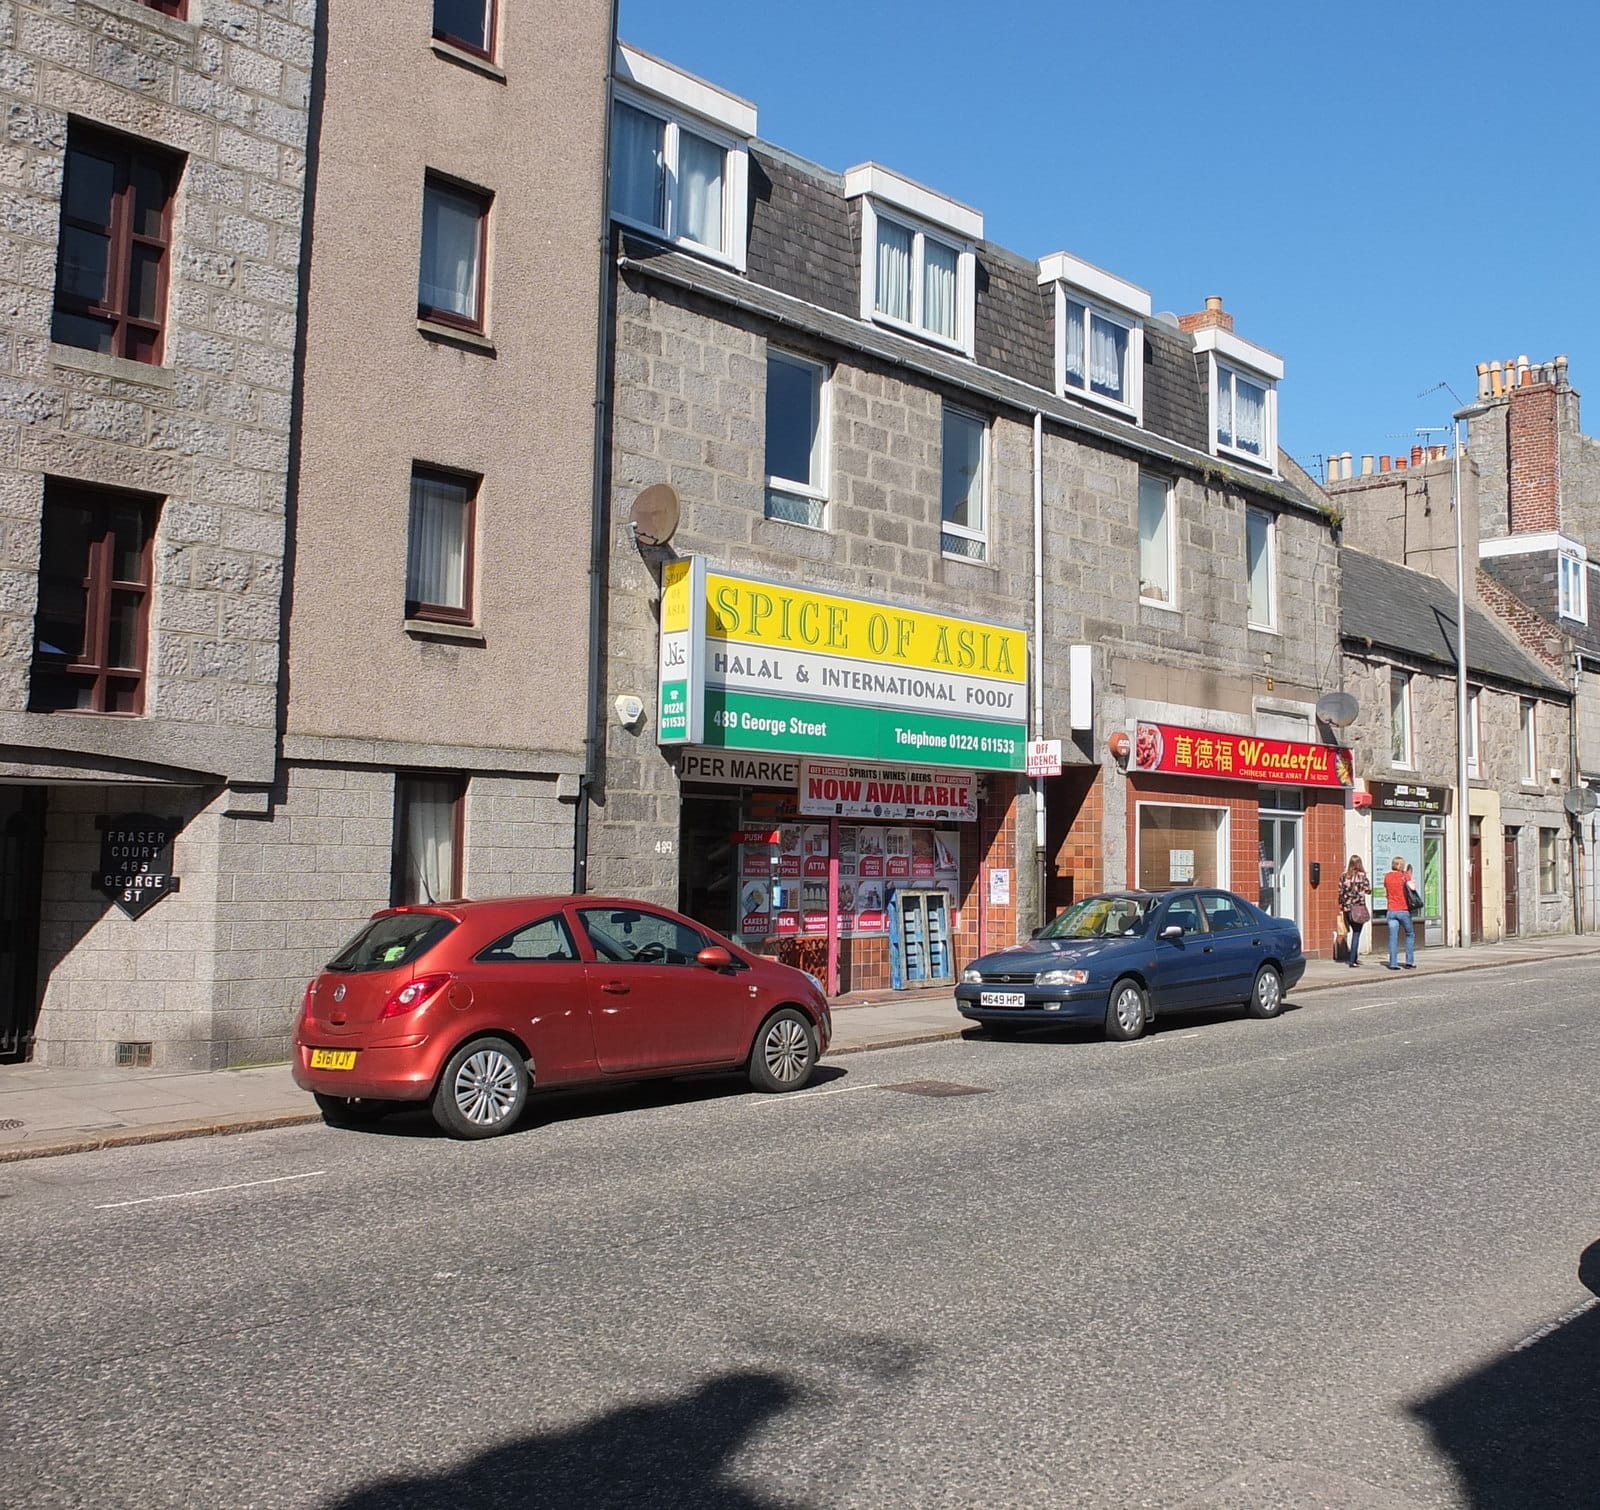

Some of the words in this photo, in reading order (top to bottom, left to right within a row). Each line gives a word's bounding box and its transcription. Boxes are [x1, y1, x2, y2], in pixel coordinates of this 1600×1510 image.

[715, 586, 849, 649] SPICE
[867, 612, 915, 659] OF
[931, 624, 1015, 675] ASIA
[714, 653, 783, 680] HALAL
[796, 664, 810, 684] &
[822, 667, 956, 702] INTERNATIONAL
[966, 687, 1014, 709] FOODS
[663, 702, 684, 715] 01224
[662, 716, 685, 729] 611533
[713, 710, 738, 728] 489
[741, 712, 787, 736] George
[789, 717, 827, 737] Street
[895, 728, 947, 749] Telephone
[949, 733, 979, 751] 01224
[981, 737, 1015, 754] 611533
[1035, 743, 1049, 755] OFF
[1174, 735, 1233, 772] 萬德福
[1027, 754, 1059, 766] LICENCE
[1238, 740, 1328, 780] Wonderful
[821, 767, 847, 777] LICENCE
[849, 768, 878, 779] SPIRITS
[882, 770, 906, 782] WINES
[911, 772, 932, 783] BEERS
[1239, 768, 1267, 778] CHINESE
[1268, 771, 1284, 779] TAKE
[1285, 772, 1303, 780] AWAY
[808, 778, 862, 801] NOW
[865, 782, 968, 807] AVAILABLE
[108, 831, 165, 843] FRASER
[744, 833, 763, 841] PUSH
[1377, 833, 1391, 843] CASH
[1391, 831, 1397, 843] 4
[1397, 834, 1419, 844] CLOTHES
[111, 846, 159, 858] COURT
[120, 861, 149, 873] 485
[808, 862, 826, 871] ATTA
[105, 875, 163, 888] GEORGE
[123, 890, 142, 902] ST
[743, 918, 761, 926] CAKES
[779, 917, 795, 927] RICE
[743, 925, 768, 933] BREADS
[982, 993, 1005, 1005] M649
[1006, 994, 1024, 1005] HPC
